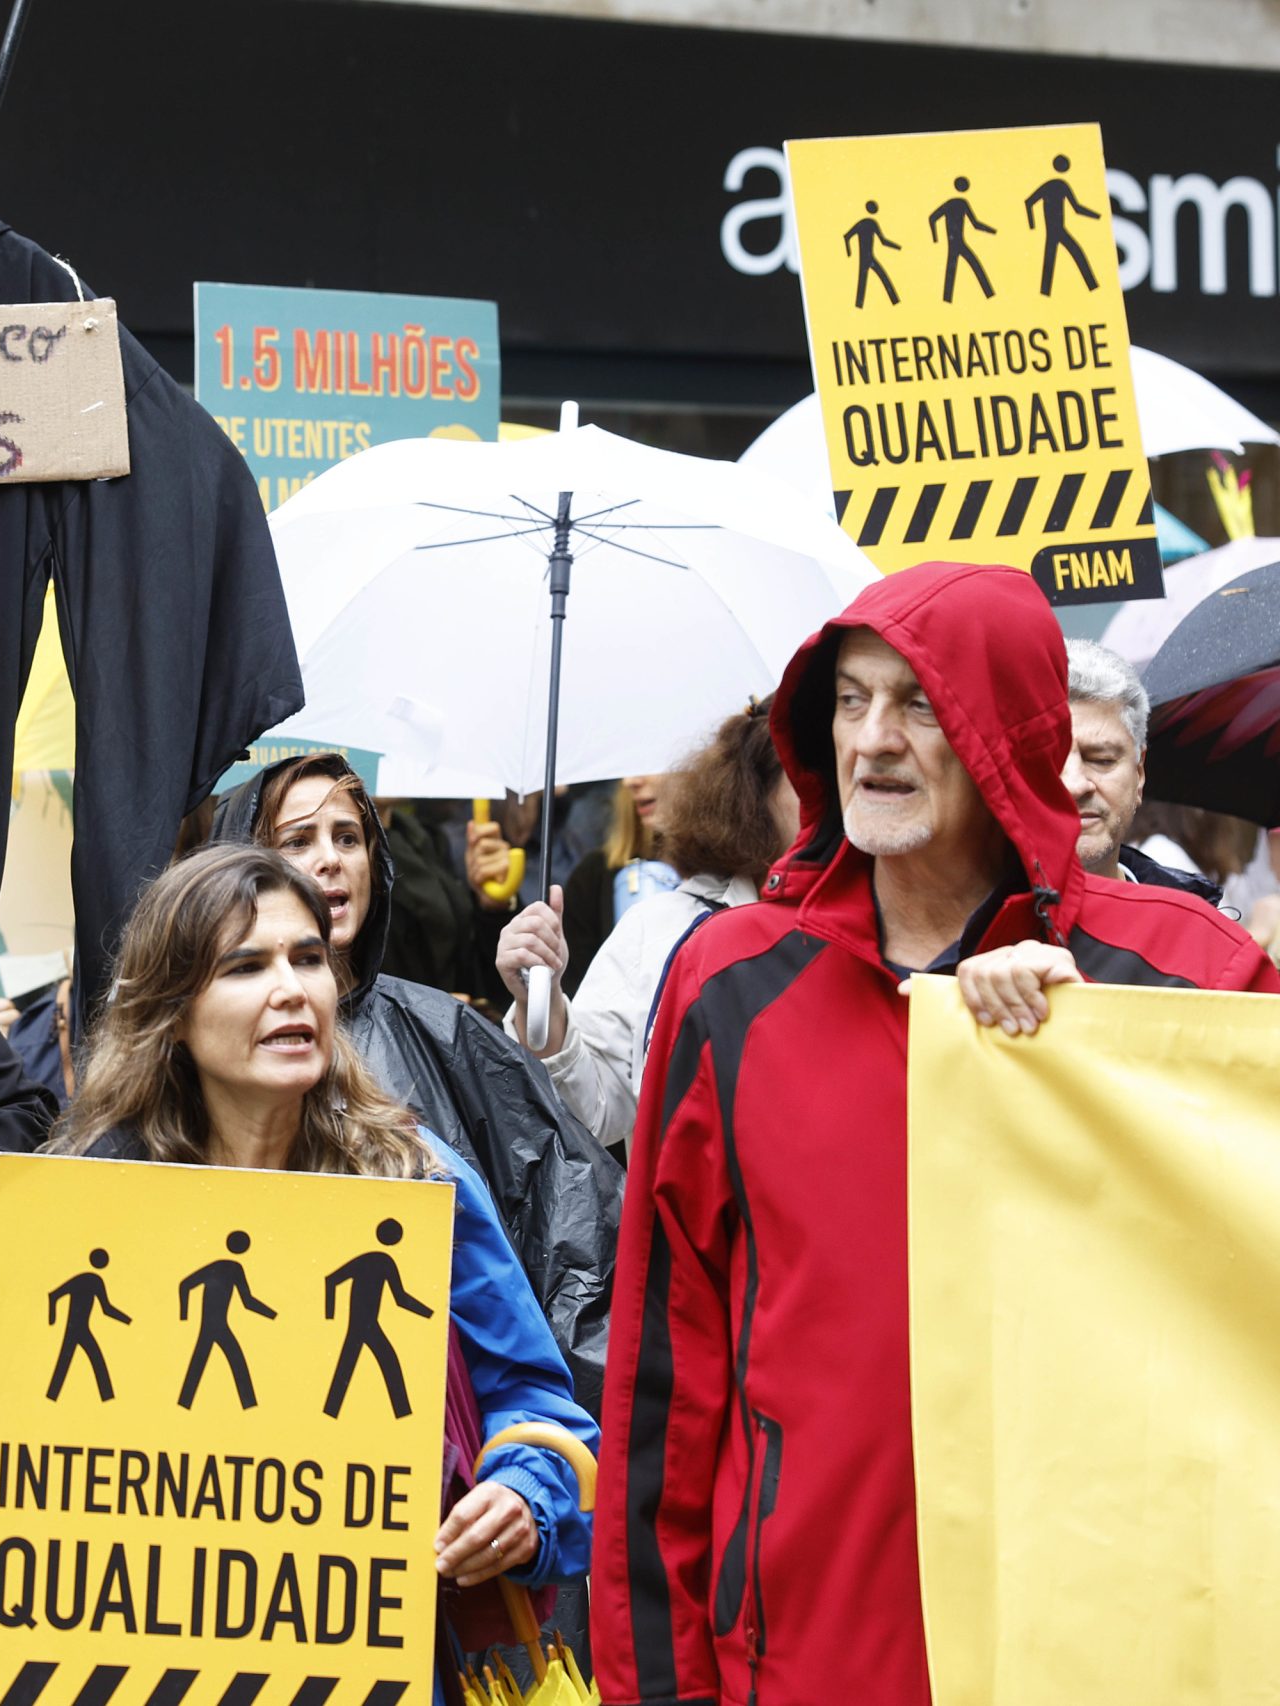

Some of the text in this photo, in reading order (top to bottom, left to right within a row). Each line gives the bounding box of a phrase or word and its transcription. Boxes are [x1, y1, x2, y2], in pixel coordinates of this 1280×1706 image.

[214, 323, 481, 402] 1.5 MILHÕES
[831, 323, 1113, 387] INTERNATOS DE
[252, 417, 372, 460] UTENTES
[842, 386, 1125, 467] QUALIDADE
[1051, 548, 1135, 591] FNAM
[343, 1461, 412, 1532] DE
